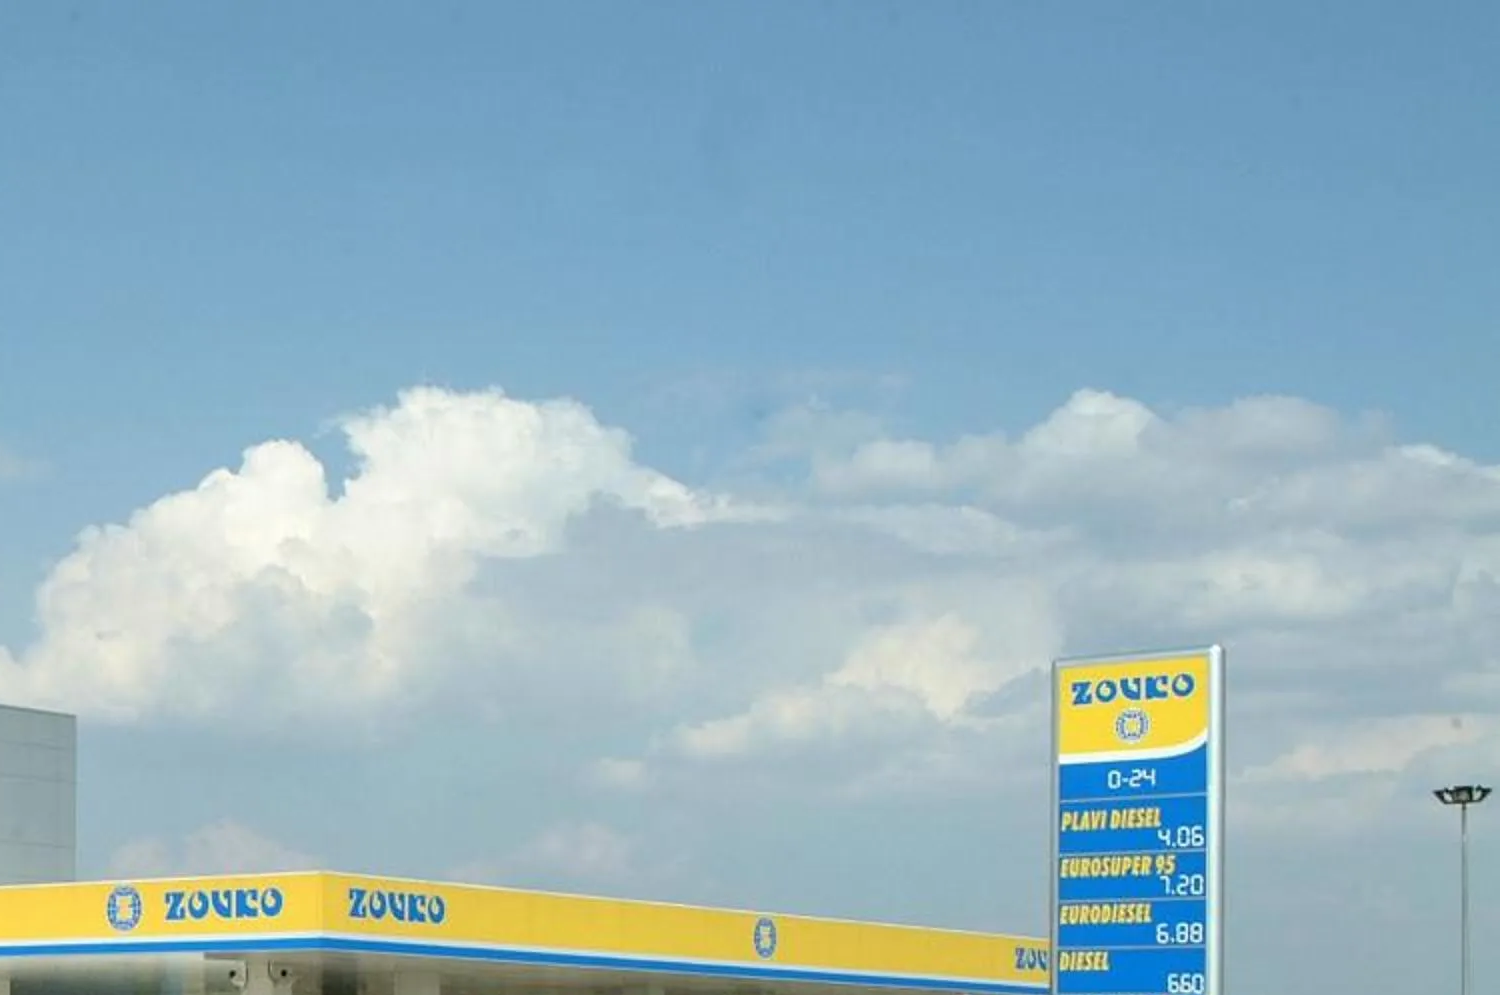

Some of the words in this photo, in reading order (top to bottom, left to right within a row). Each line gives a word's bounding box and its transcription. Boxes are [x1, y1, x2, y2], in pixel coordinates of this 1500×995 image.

[1107, 768, 1156, 790] 0-24
[1061, 810, 1108, 831] PLAVI
[1110, 807, 1161, 829] DIESEL
[1157, 825, 1205, 848] 4.06
[1059, 856, 1152, 878] EUROSUPER
[1155, 854, 1176, 875] 95
[1159, 874, 1204, 895] 7.20
[1059, 903, 1152, 925] EURODIESEL
[1059, 951, 1109, 971] DIESEL
